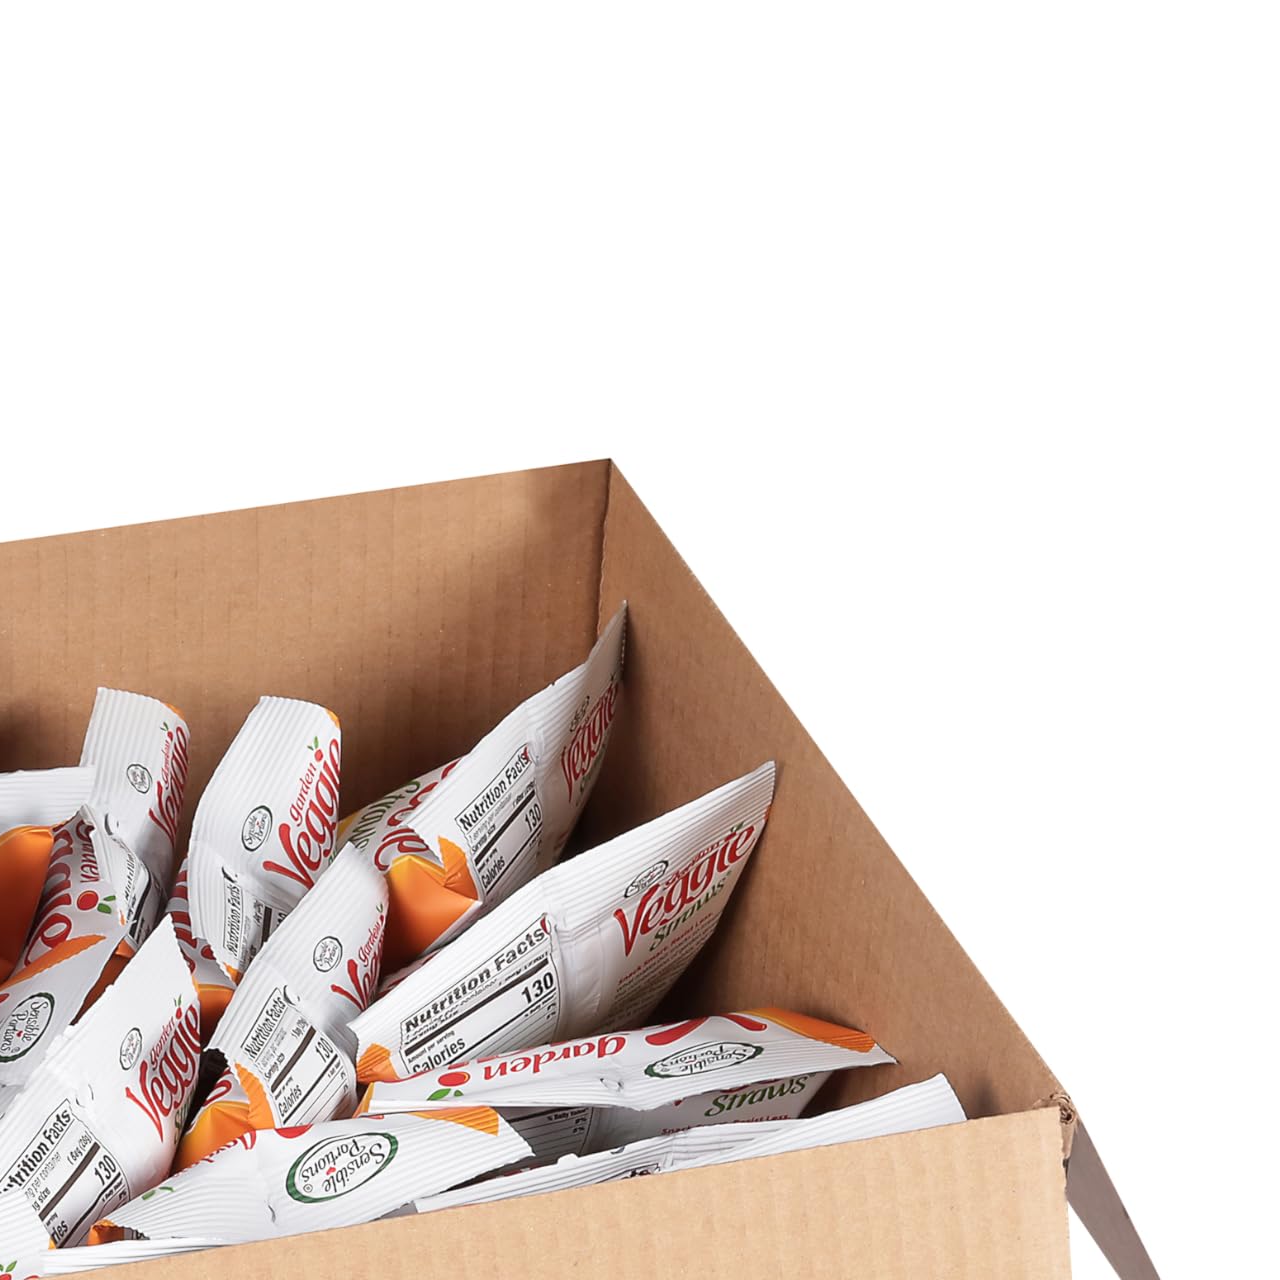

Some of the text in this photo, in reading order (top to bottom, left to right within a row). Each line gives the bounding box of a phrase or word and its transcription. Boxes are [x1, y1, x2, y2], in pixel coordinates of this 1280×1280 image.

[289, 762, 318, 827] garden
[459, 779, 507, 831] Nutrition
[506, 752, 531, 785] Facts
[525, 802, 543, 833] 130
[480, 855, 506, 889] Calories
[613, 825, 756, 957] Veggie
[404, 967, 493, 1033] Nutrition
[493, 927, 546, 972] Facts
[521, 971, 554, 1005] 130
[151, 1015, 176, 1071] garden
[245, 1016, 276, 1060] Nutrition
[265, 996, 287, 1019] Facts
[315, 1036, 334, 1063] 130
[125, 1004, 200, 1143] Veggie
[413, 1037, 467, 1074] Calories
[482, 1034, 627, 1081] garden
[278, 1085, 304, 1117] Calories
[704, 1075, 808, 1117] Straws
[43, 1110, 72, 1146] Facts
[94, 1153, 118, 1187] 130
[302, 1138, 365, 1183] Portions
[323, 1142, 386, 1194] Sensible
